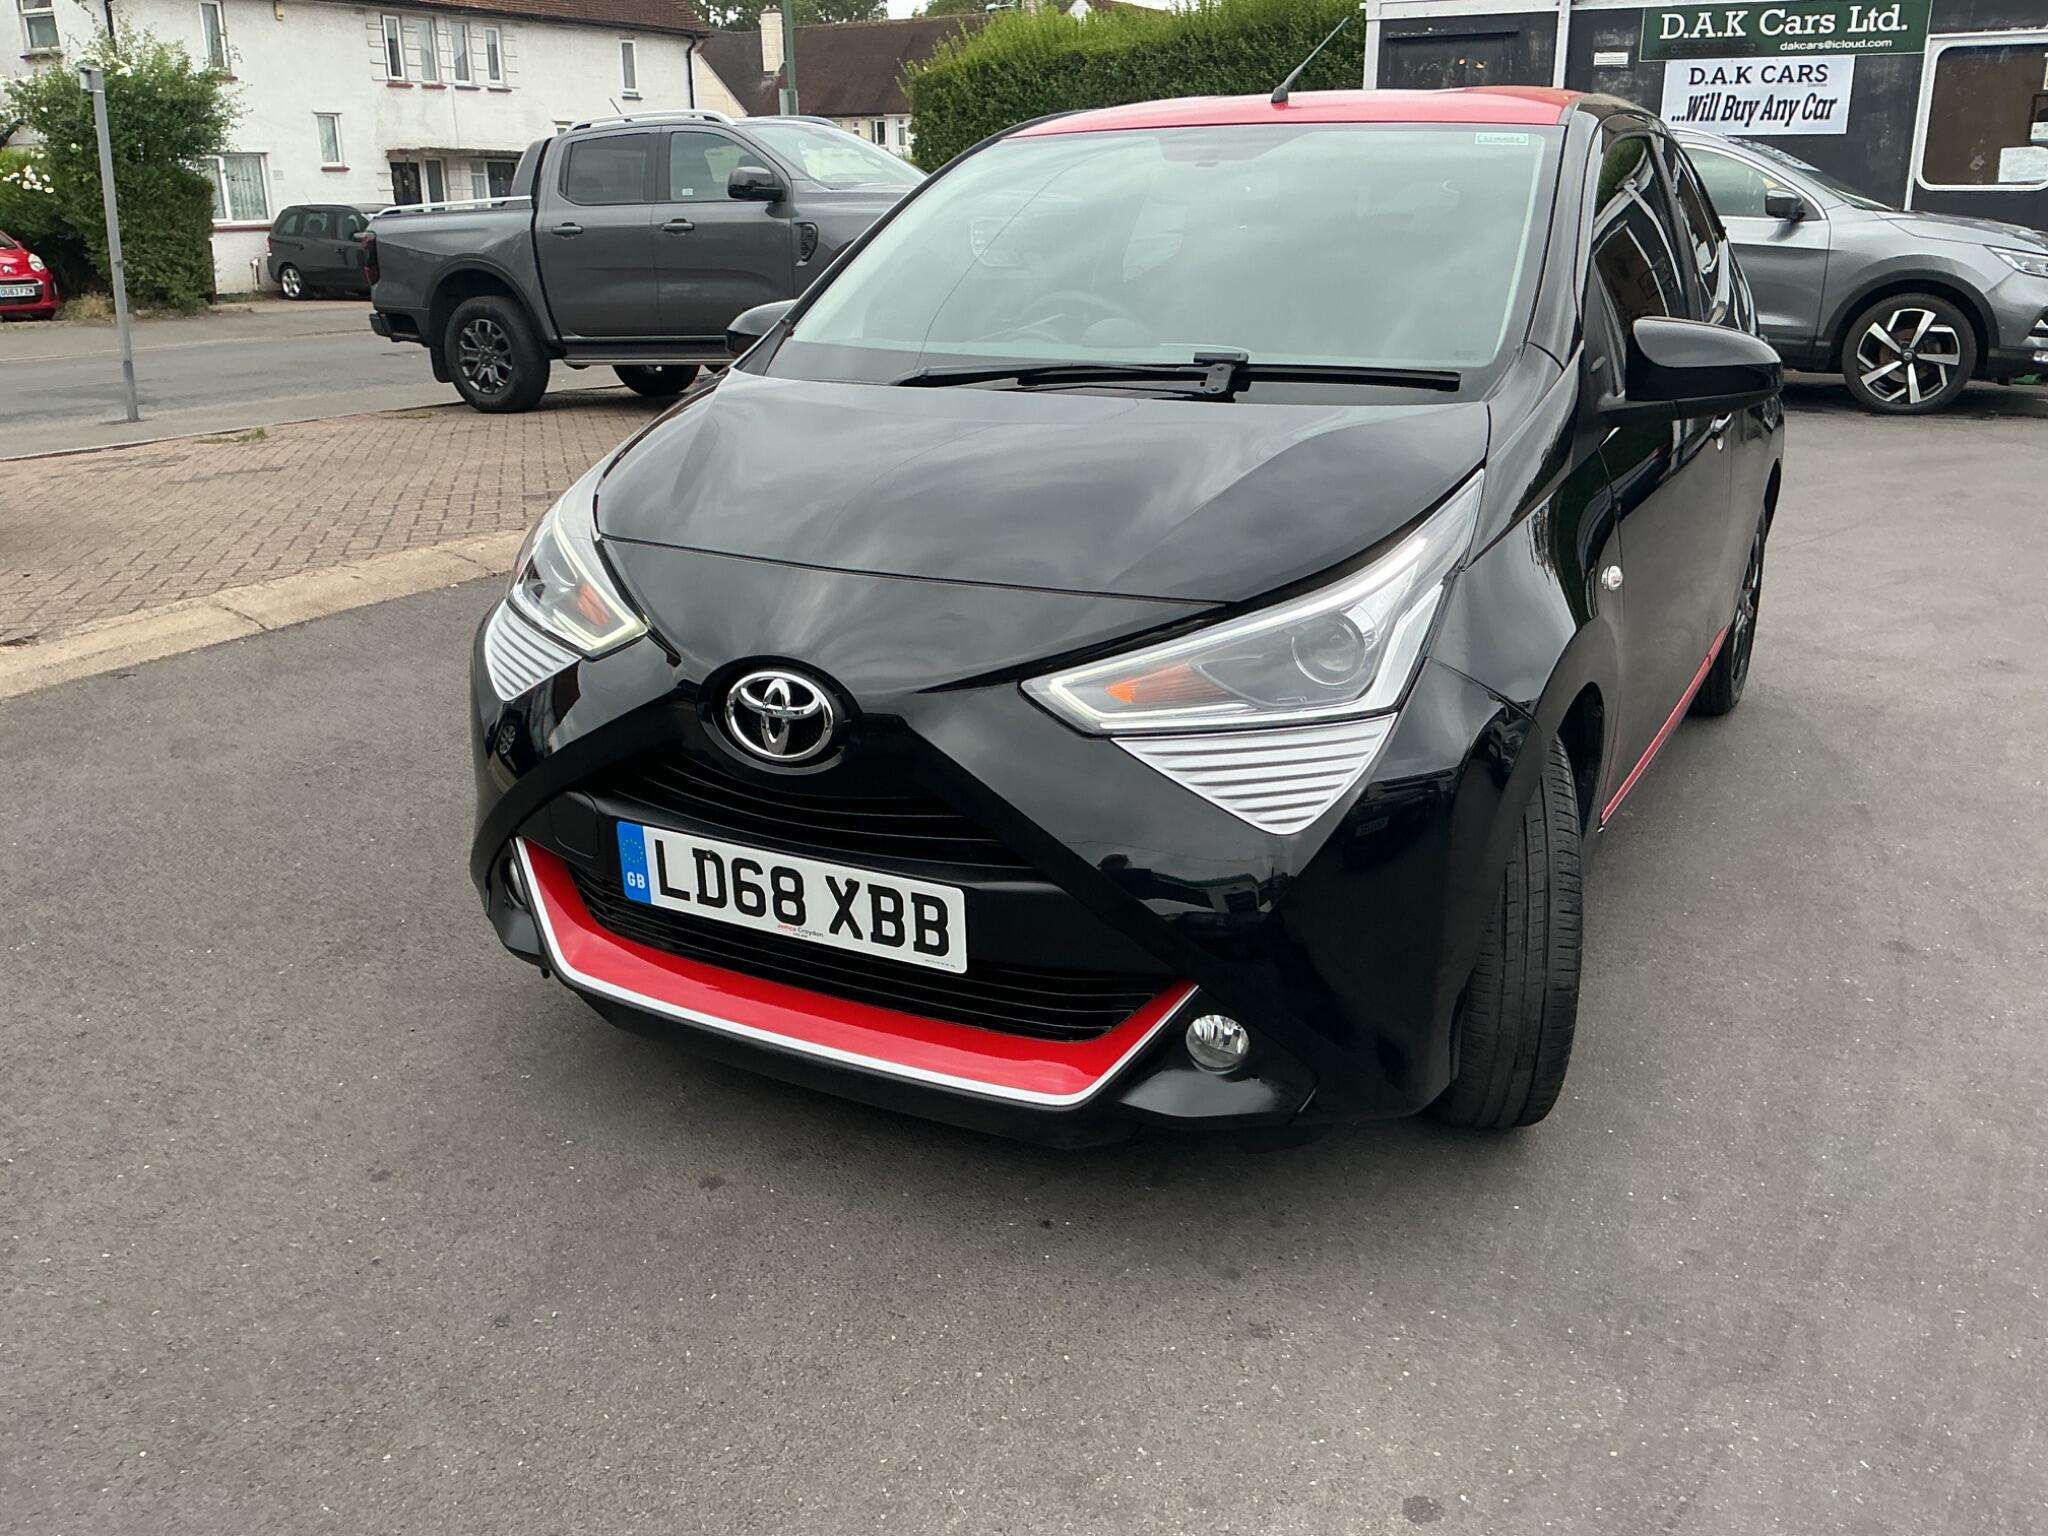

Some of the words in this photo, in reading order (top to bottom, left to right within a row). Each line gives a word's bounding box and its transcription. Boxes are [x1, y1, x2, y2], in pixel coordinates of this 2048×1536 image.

[1660, 10, 1748, 39] D.A.K
[1759, 8, 1836, 36] Cars
[1847, 3, 1908, 33] Ltd.
[1780, 39, 1893, 51] dakcars@icloud.com
[1689, 65, 1752, 85] D.A.K
[1760, 64, 1829, 84] CARS
[1720, 94, 1760, 128] Buy
[1759, 93, 1800, 128] Any
[1801, 92, 1839, 121] Car
[627, 871, 646, 889] GB
[654, 839, 807, 926] LD68
[825, 875, 950, 957] XBB
